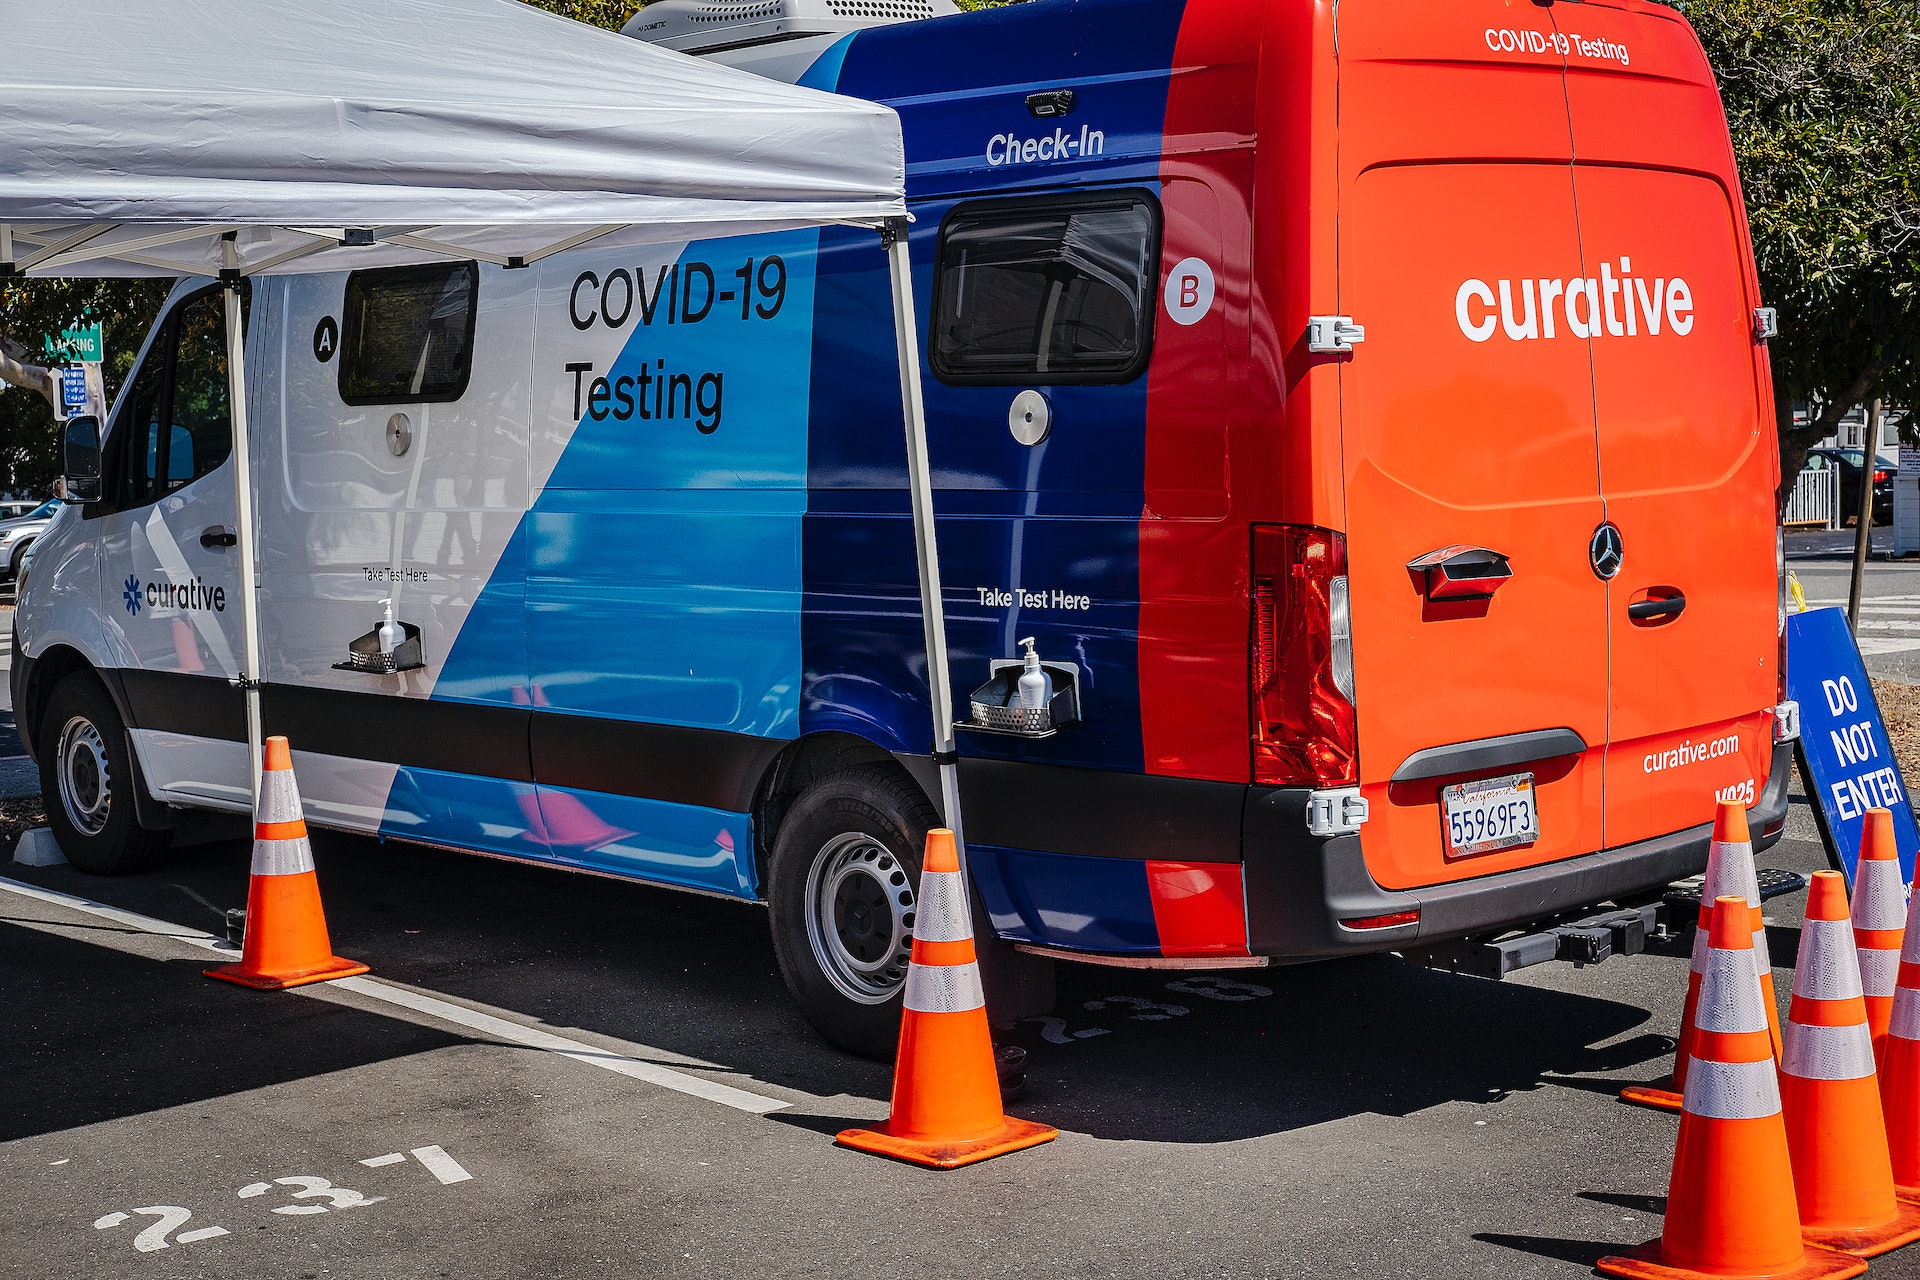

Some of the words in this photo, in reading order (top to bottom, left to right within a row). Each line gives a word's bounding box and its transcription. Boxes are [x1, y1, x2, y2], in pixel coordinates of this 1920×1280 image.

[1485, 28, 1570, 55] COVID-19
[1569, 33, 1630, 66] Testing
[985, 123, 1104, 166] Check-In
[568, 254, 787, 331] COVID-19
[1180, 275, 1199, 308] B
[1455, 256, 1694, 342] curative
[318, 327, 331, 352] A
[564, 358, 724, 435] Testing
[146, 576, 226, 612] curative
[362, 567, 383, 582] Take
[384, 567, 404, 582] Test
[405, 567, 428, 582] Here
[976, 587, 1012, 607] Take
[1015, 588, 1048, 609] Test
[1051, 589, 1090, 611] Here
[1821, 675, 1858, 717] DO
[1643, 734, 1739, 773] curative.com
[1830, 721, 1878, 768] NOT
[1831, 766, 1903, 821] ENTER
[1451, 800, 1531, 843] 55969F3
